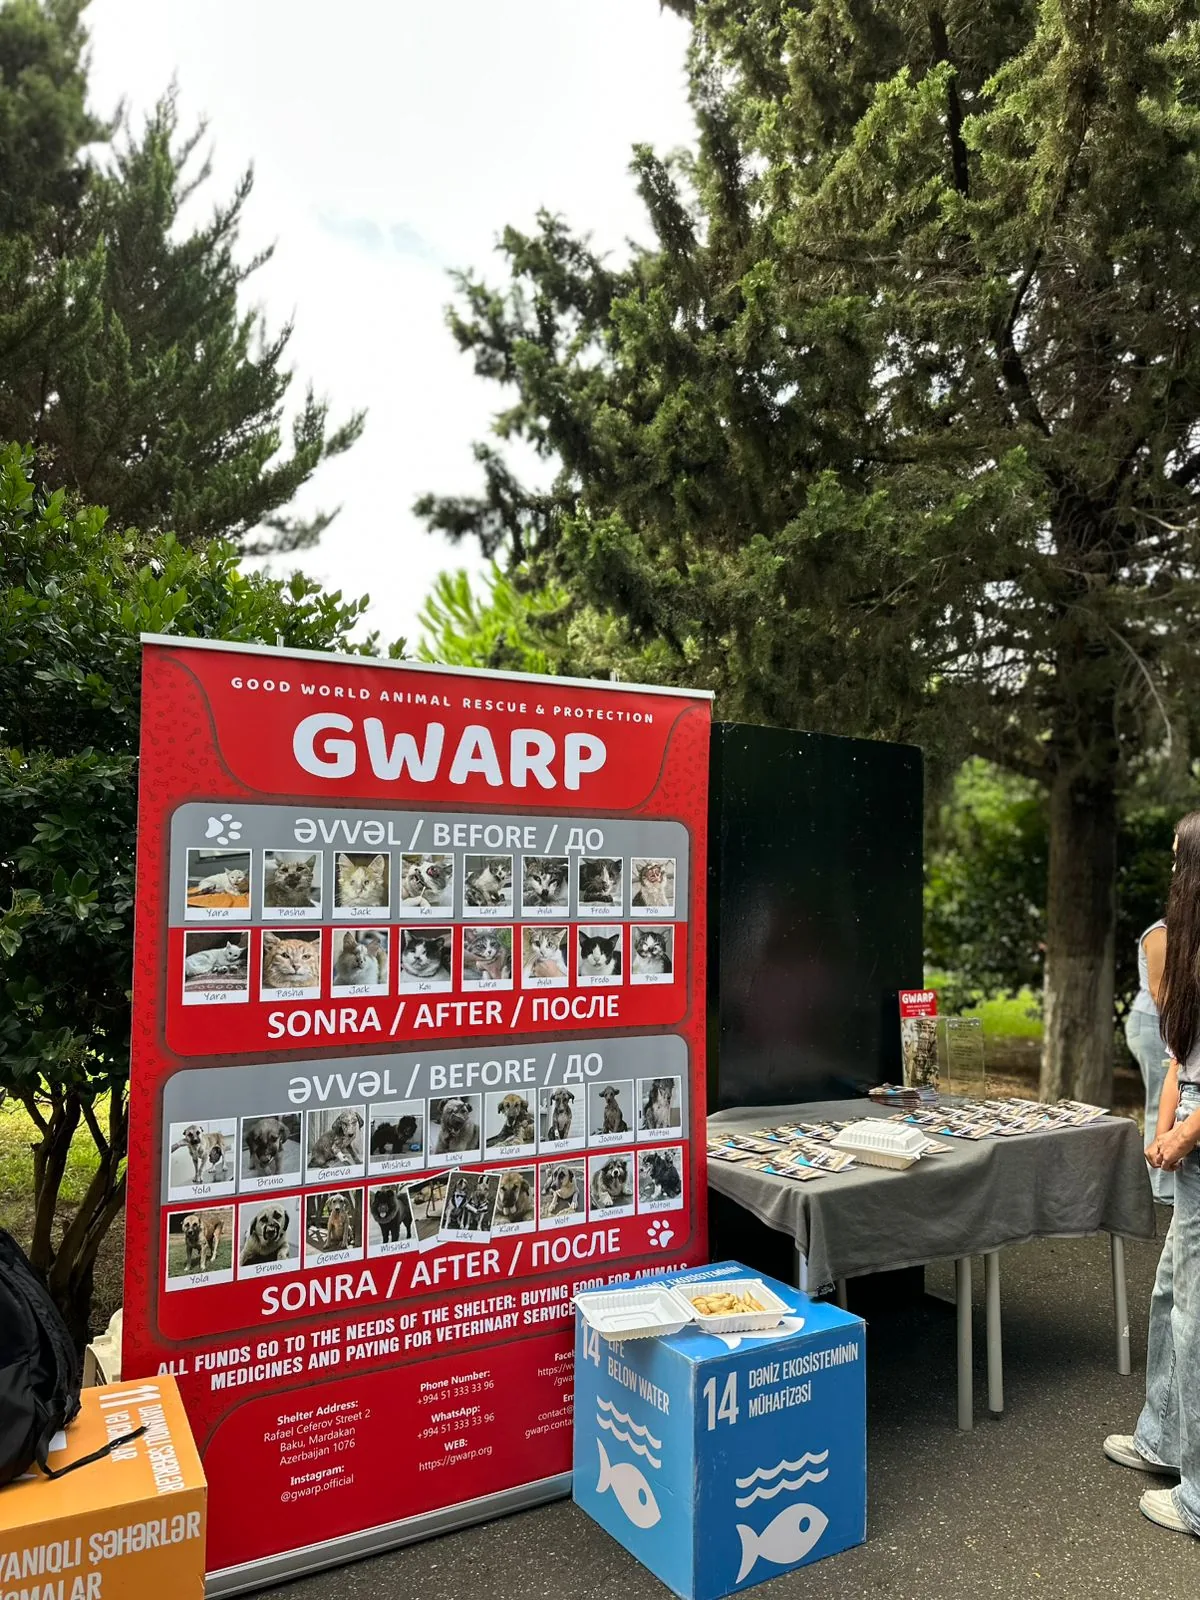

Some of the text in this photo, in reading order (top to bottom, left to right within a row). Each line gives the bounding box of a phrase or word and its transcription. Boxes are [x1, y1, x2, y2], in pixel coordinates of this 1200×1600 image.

[231, 677, 654, 724] GOOD WORLD ANIMAL RESCUE & PROTECTION
[292, 712, 607, 790] GWARP
[433, 822, 537, 849] BEFORE
[564, 827, 604, 855] ДО
[206, 908, 229, 918] Yara
[278, 907, 306, 917] Pasha
[350, 907, 372, 917] Jack
[590, 907, 610, 915] Fredo
[348, 985, 370, 995] Jack
[590, 975, 610, 984] Fredo
[204, 991, 227, 1001] Yara
[276, 988, 304, 998] Pasha
[902, 992, 934, 1004] GWARP
[267, 1006, 381, 1038] SONRA
[413, 1000, 502, 1028] AFTER
[532, 994, 619, 1022] ПОСЛЕ
[430, 1058, 536, 1090] BEFORE
[563, 1052, 603, 1084] ДО
[257, 1177, 284, 1187] Bruno
[318, 1168, 351, 1180] Geneva
[191, 1185, 211, 1194] Yola
[255, 1262, 283, 1274] Bruno
[317, 1250, 350, 1264] Geneva
[189, 1274, 209, 1284] Yola
[261, 1270, 378, 1316] SONRA
[410, 1249, 501, 1289] AFTER
[532, 1228, 620, 1267] ПОСЛЕ
[157, 1358, 188, 1377] ALL
[194, 1346, 250, 1373] FUNDS
[256, 1340, 279, 1360] GO
[284, 1335, 305, 1353] TO
[310, 1328, 341, 1349] THE
[346, 1317, 395, 1341] NEEDS
[400, 1313, 417, 1330] OF
[422, 1306, 450, 1325] THE
[453, 1294, 516, 1319] SHELTER:
[521, 1284, 568, 1306] BUYING
[572, 1277, 604, 1296] FOOD
[608, 1272, 630, 1287] FOR
[211, 1356, 303, 1391] MEDICINES
[307, 1349, 340, 1370] AND
[346, 1336, 399, 1361] PAYING
[405, 1328, 431, 1348] FOR
[436, 1312, 519, 1343] VETERINARY
[581, 1316, 600, 1368] 14
[417, 1379, 495, 1405] +994 51 333 33 96
[420, 1370, 491, 1392] Phone Number:
[608, 1356, 670, 1416] BELOW WATER
[703, 1341, 859, 1431] 14 DƏNİZ EKOSİSTEMİNİN
[99, 1385, 161, 1408] 11
[748, 1380, 812, 1418] MÜHAFİZƏSİ
[263, 1408, 371, 1442] Rafael Ceferov Street 2
[277, 1400, 359, 1426] Shelter Address:
[417, 1412, 495, 1439] +994 51 333 33 96
[431, 1405, 481, 1423] WhatsApp:
[279, 1438, 356, 1466] Azerbaijan 1076
[280, 1426, 356, 1452] Baku, Mardakan
[444, 1438, 468, 1451] WEB:
[418, 1445, 493, 1472] https://gwarp.org
[280, 1474, 354, 1502] @gwarp.official
[290, 1465, 345, 1486] Instagram:
[88, 1511, 201, 1566] ŞƏHƏRLƏR
